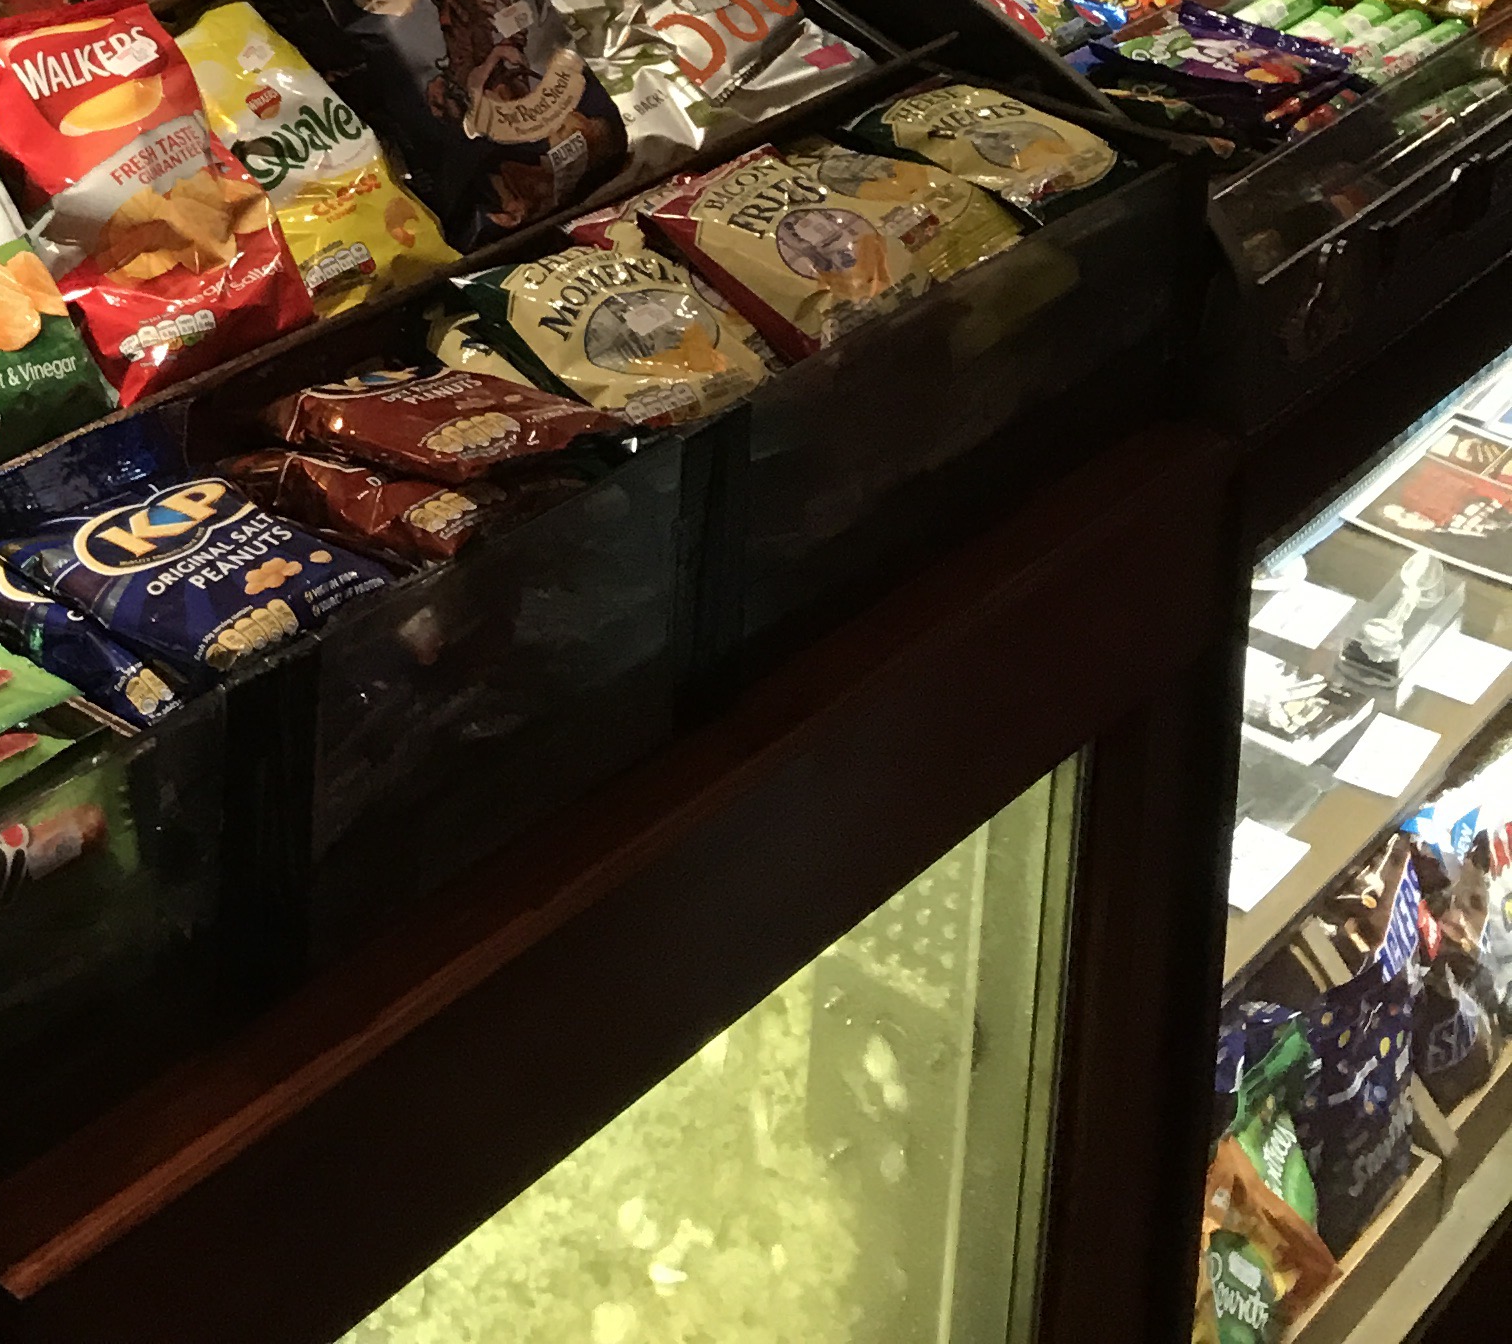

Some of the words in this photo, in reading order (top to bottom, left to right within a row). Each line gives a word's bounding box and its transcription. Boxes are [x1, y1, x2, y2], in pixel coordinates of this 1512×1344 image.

[13, 25, 150, 102] WALKERS
[110, 142, 158, 187] FRESH
[155, 123, 202, 151] TASTE
[703, 158, 781, 213] BACON
[726, 174, 827, 240] FRIES
[7, 367, 20, 383] &
[18, 354, 77, 391] Vinegar
[405, 376, 485, 406] PEANUTS
[94, 482, 229, 558] KP
[146, 539, 232, 597] ORIGINAL
[229, 512, 274, 550] SALT
[187, 526, 293, 590] PEANUTS
